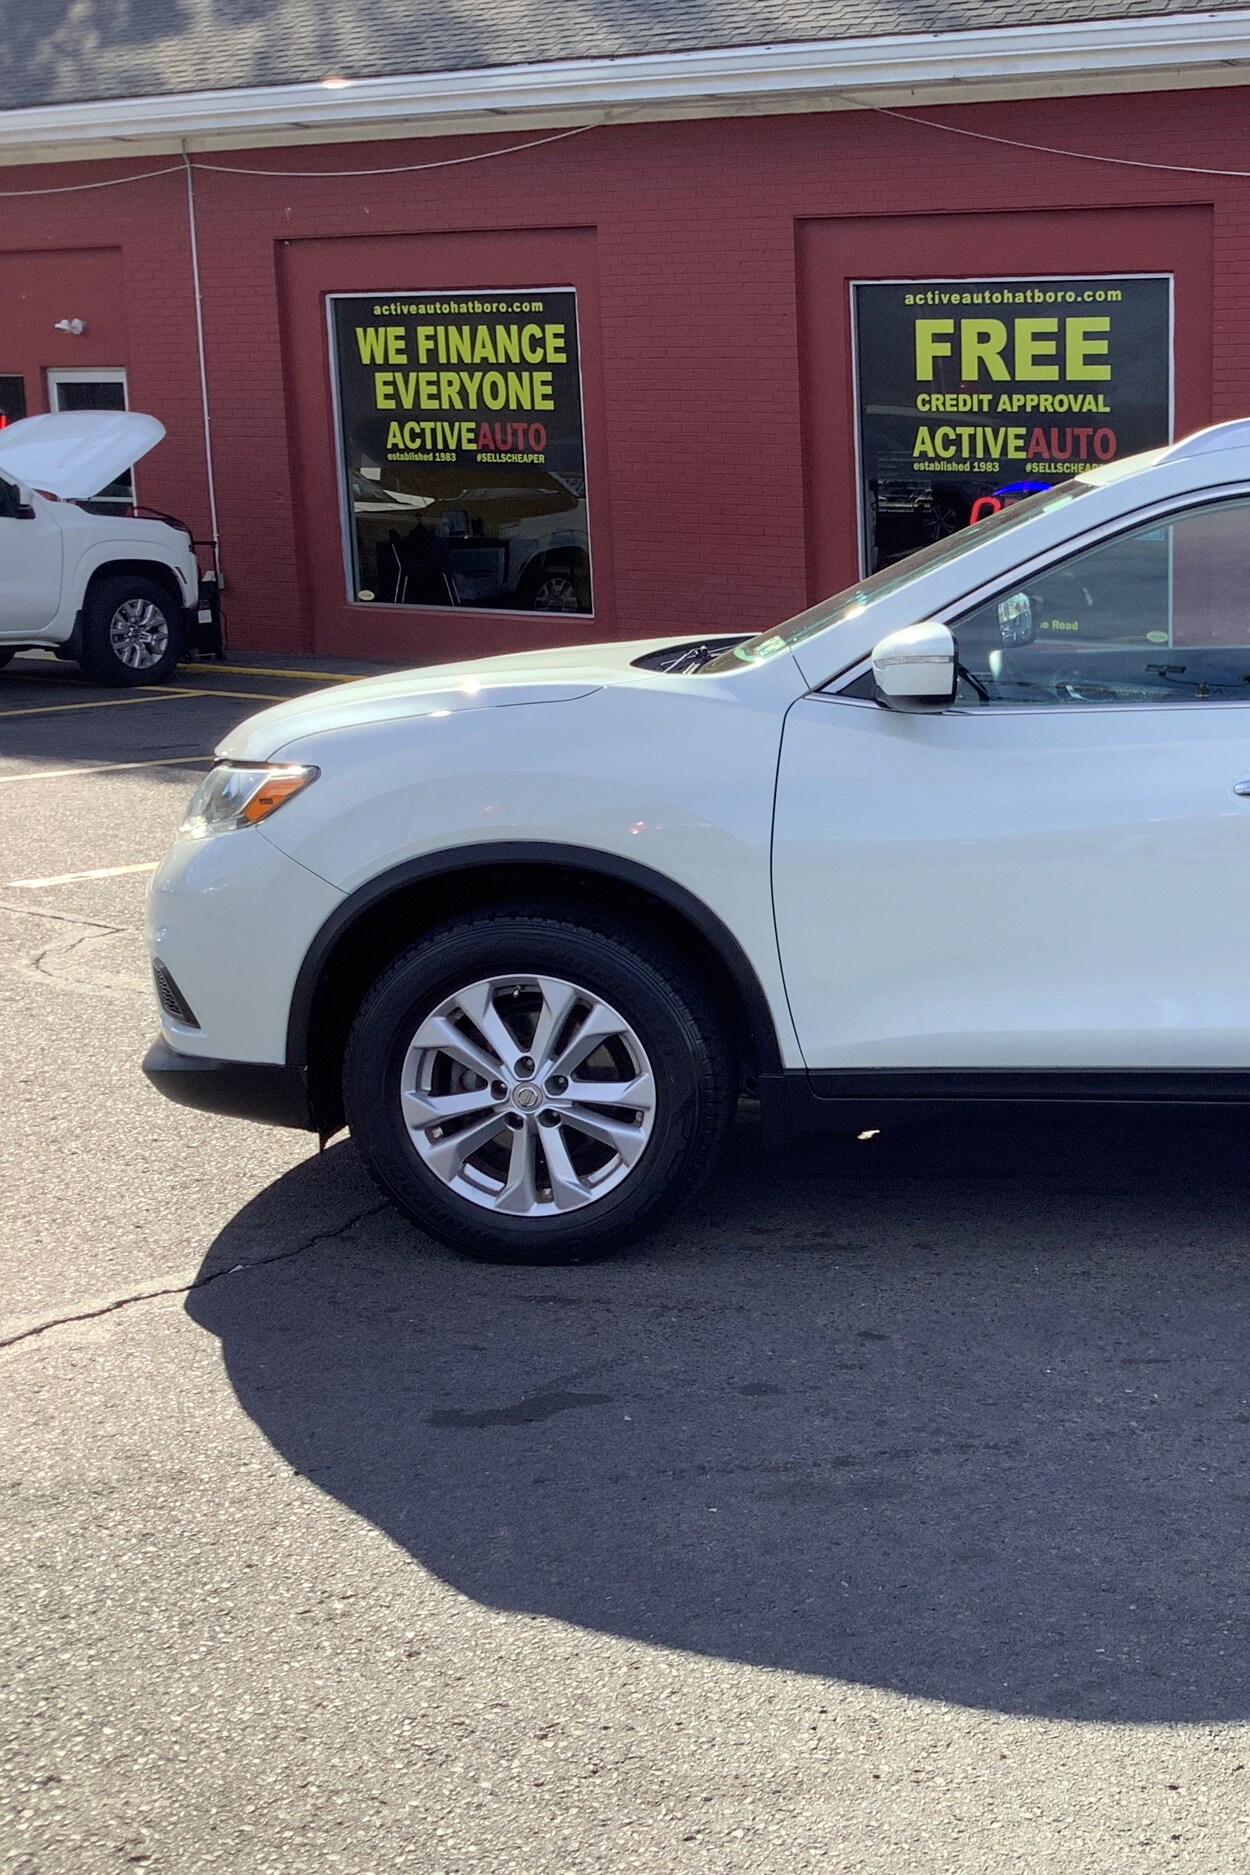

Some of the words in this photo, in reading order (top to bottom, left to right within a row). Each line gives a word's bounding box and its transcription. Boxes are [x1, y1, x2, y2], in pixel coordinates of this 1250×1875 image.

[904, 289, 1122, 305] activeautohatboro.com
[373, 301, 543, 316] activeautohatboro.com
[355, 326, 408, 365] WE
[416, 323, 567, 364] FINANCE
[915, 316, 1111, 381] FREE
[374, 371, 554, 411] EVERYONE
[916, 393, 993, 412] CREDIT
[997, 393, 1111, 413] APPROVAL
[387, 452, 433, 462] established
[434, 452, 456, 462] 1983
[476, 453, 545, 464] #SELLSCHEAPER
[913, 461, 970, 472] established
[972, 462, 1000, 473] 1983
[1052, 619, 1078, 630] Road
